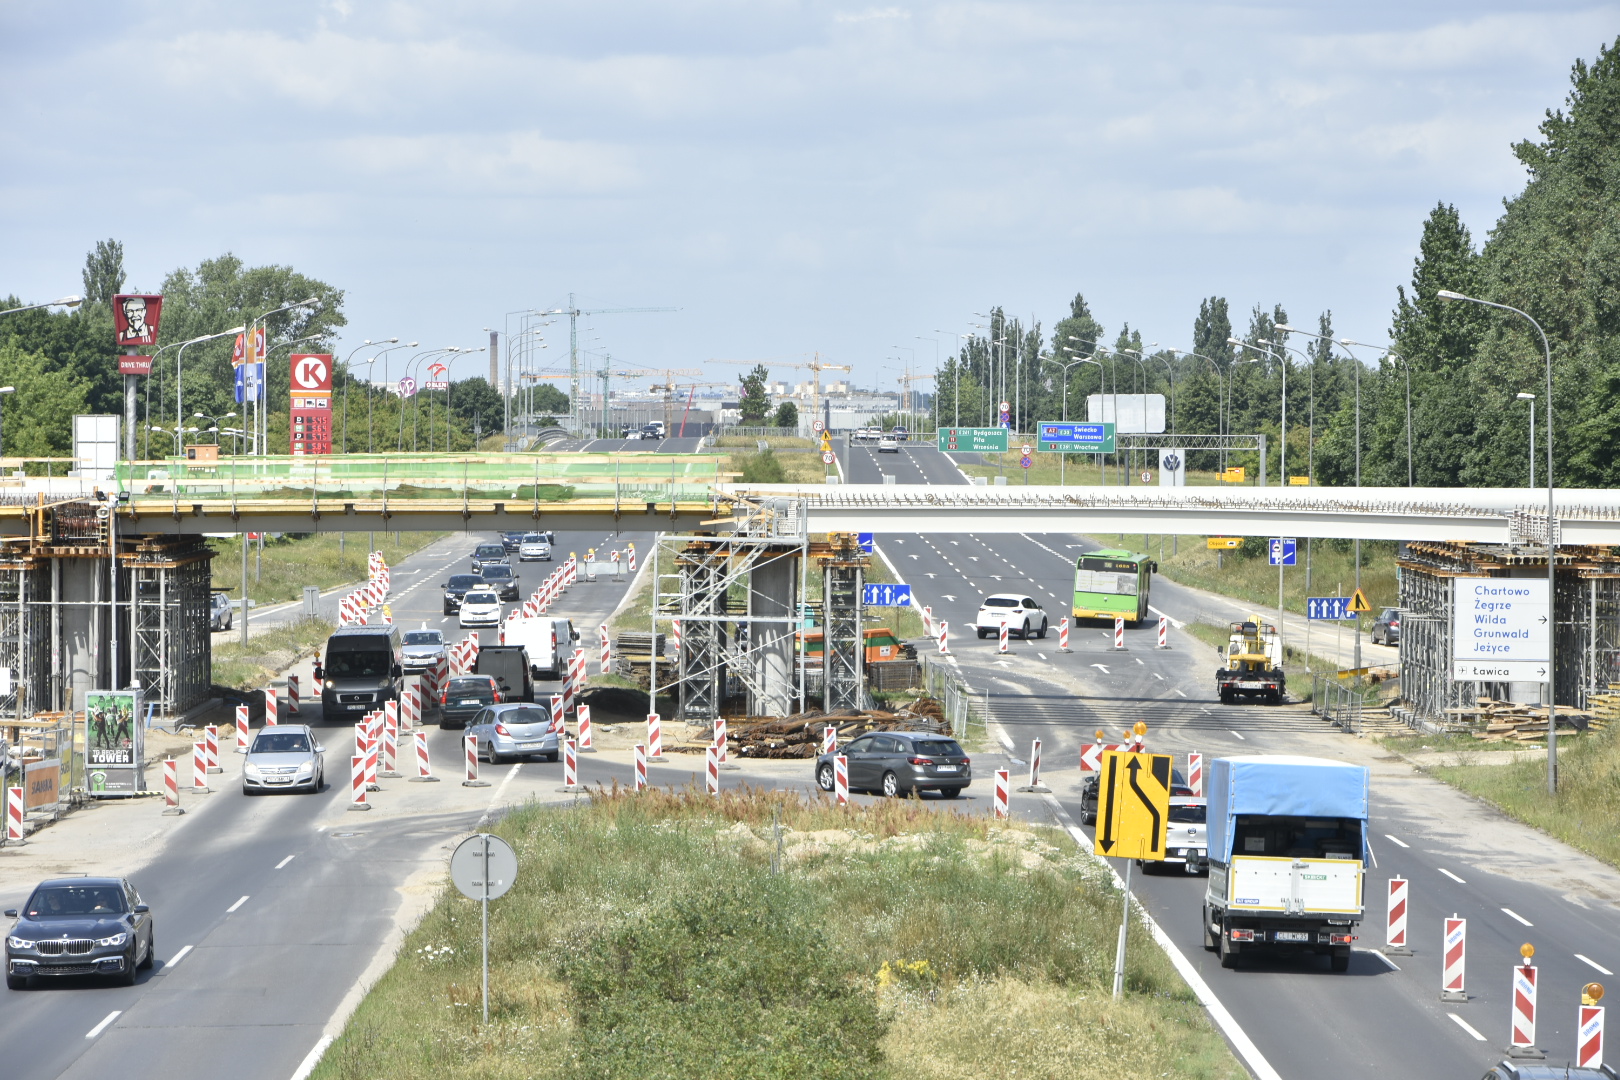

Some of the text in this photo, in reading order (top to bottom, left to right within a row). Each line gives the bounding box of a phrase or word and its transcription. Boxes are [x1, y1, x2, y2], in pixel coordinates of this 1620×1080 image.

[1474, 586, 1530, 596] Chartowo
[1474, 598, 1512, 612] Żegrze
[1474, 614, 1506, 624] Wilda
[1474, 628, 1529, 638] Grunwald
[1474, 642, 1510, 654] Jeżyce
[1473, 667, 1510, 676] Ławica
